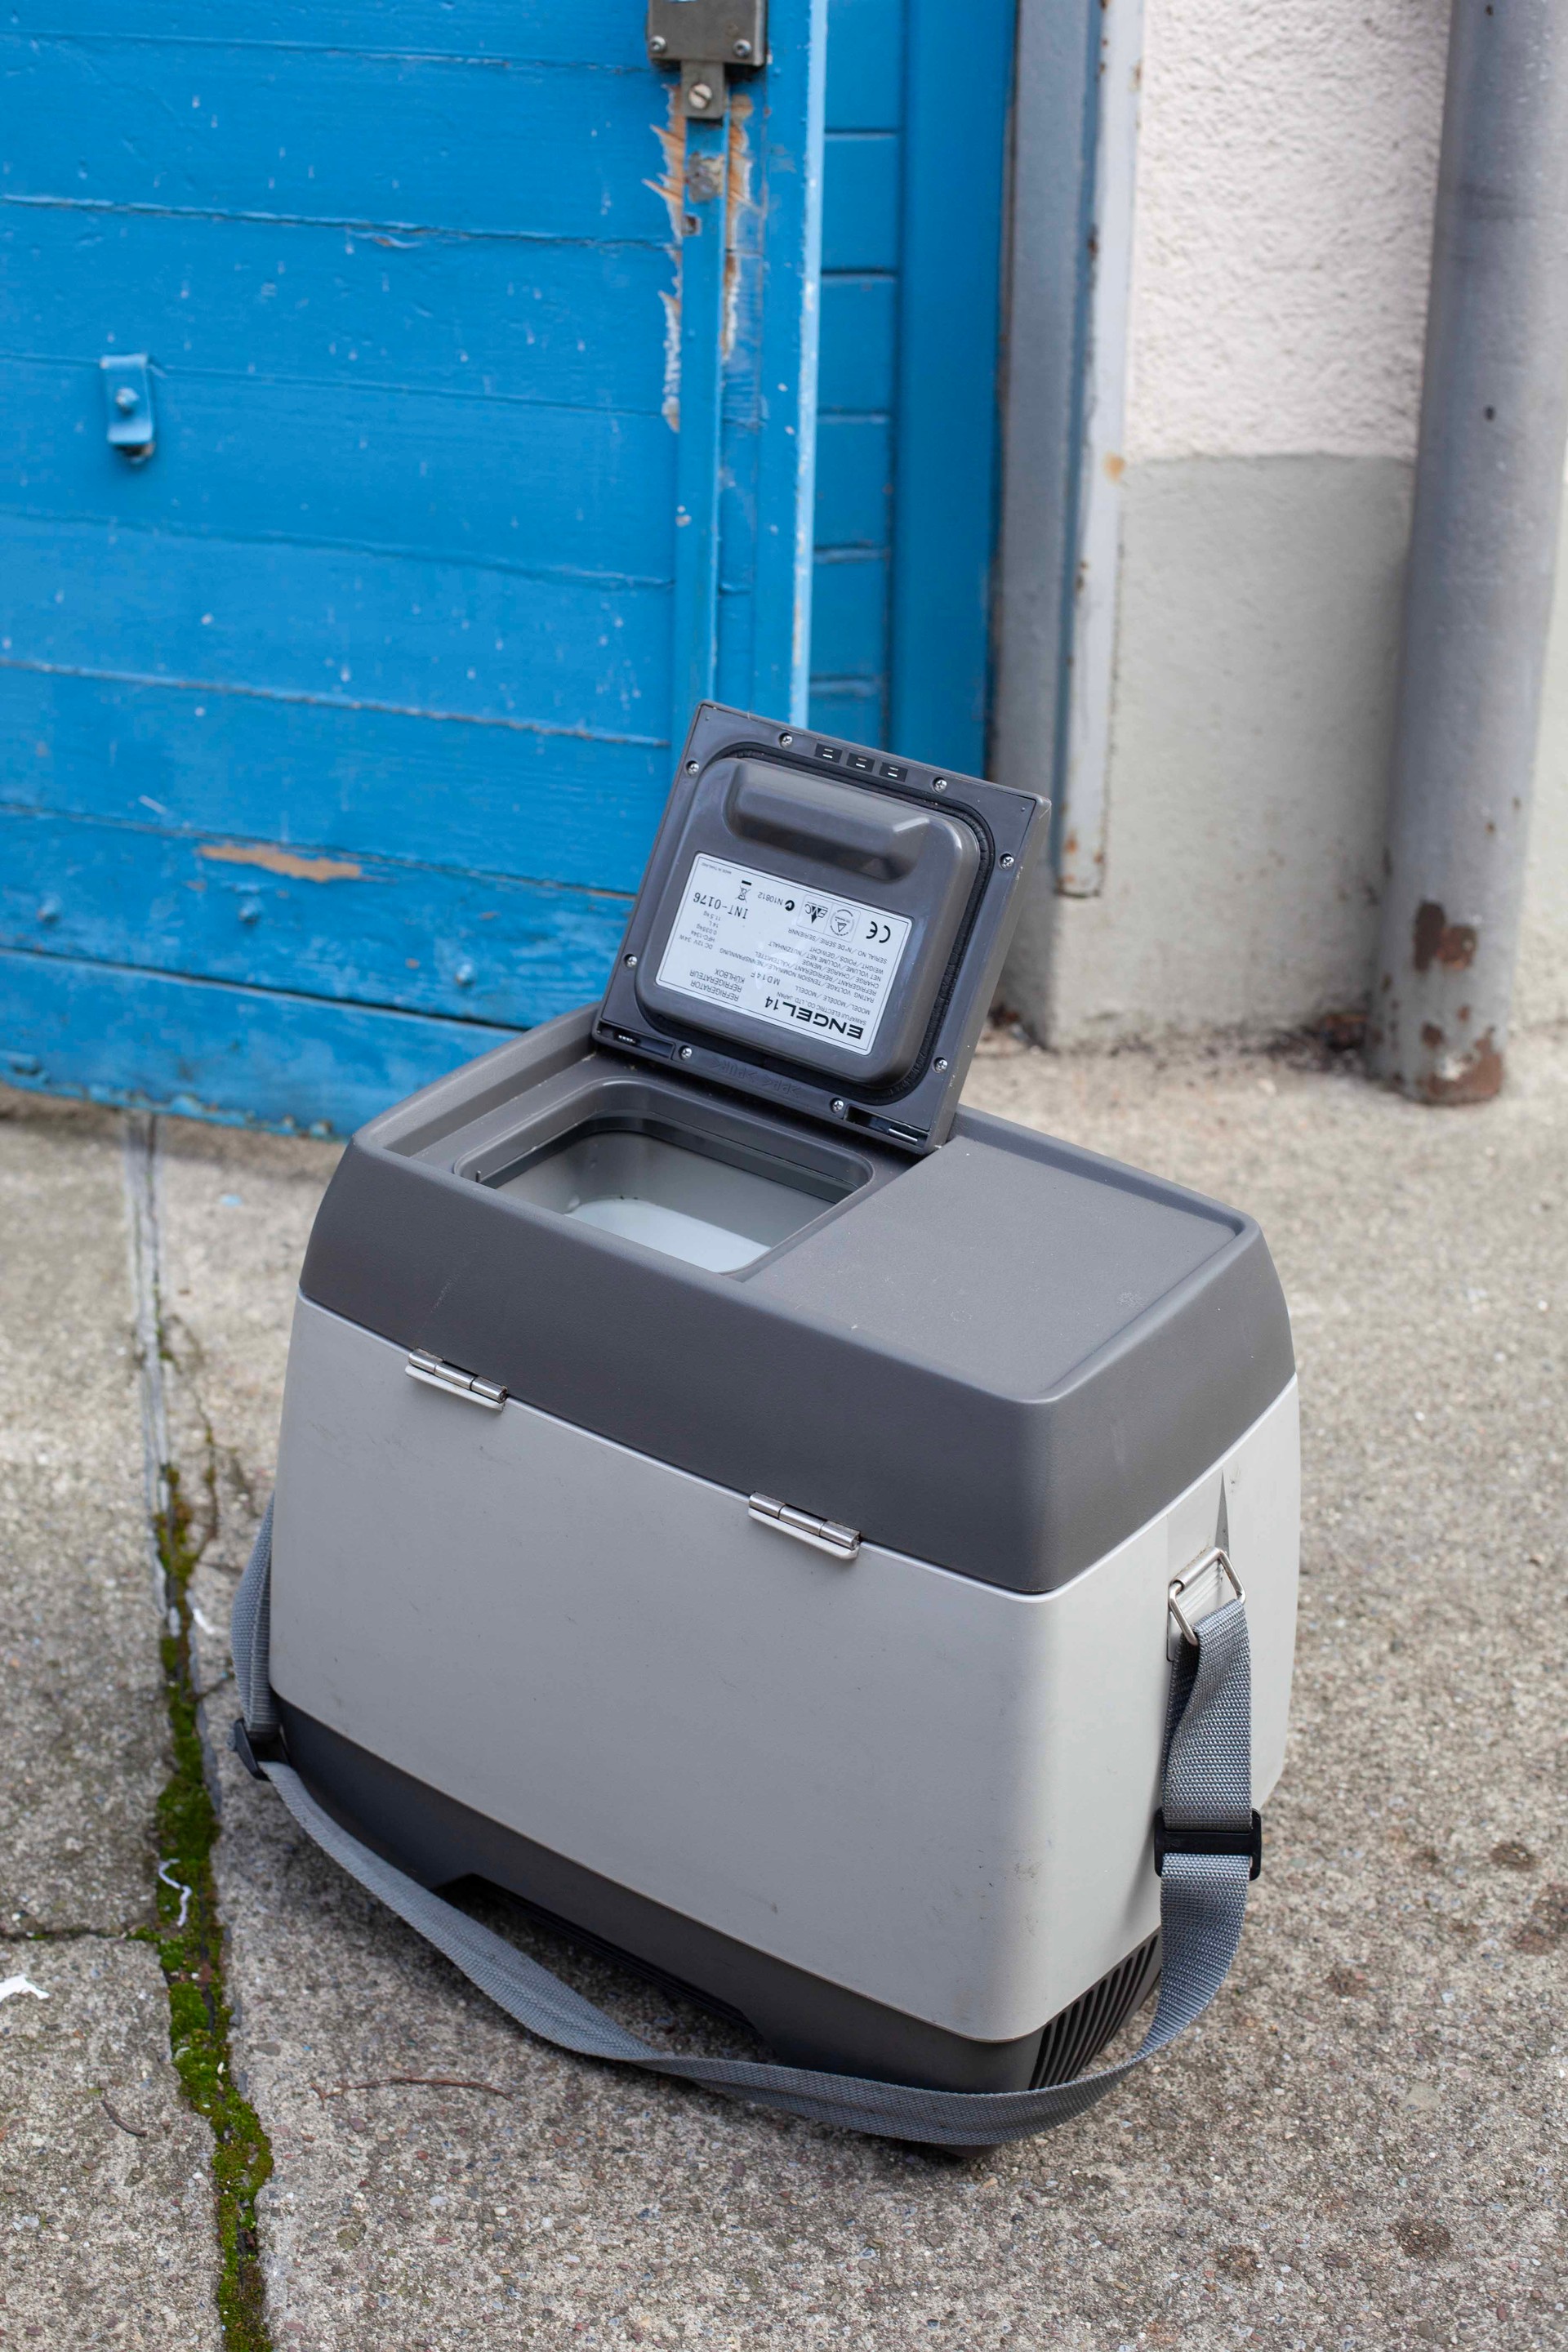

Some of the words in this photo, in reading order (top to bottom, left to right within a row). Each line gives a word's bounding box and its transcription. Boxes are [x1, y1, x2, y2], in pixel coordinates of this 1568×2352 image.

[693, 892, 749, 920] INT-0176
[867, 953, 888, 964] SERIAL
[714, 968, 746, 984] KÜHLBOX
[869, 974, 882, 982] NET
[689, 979, 740, 1002] REFRIGERATOR
[776, 991, 794, 1001] JAPAN
[853, 991, 875, 1004] RATING
[764, 996, 779, 1011] 14
[815, 1004, 842, 1018] ELECTRIC
[782, 1001, 864, 1040] ENGEL
